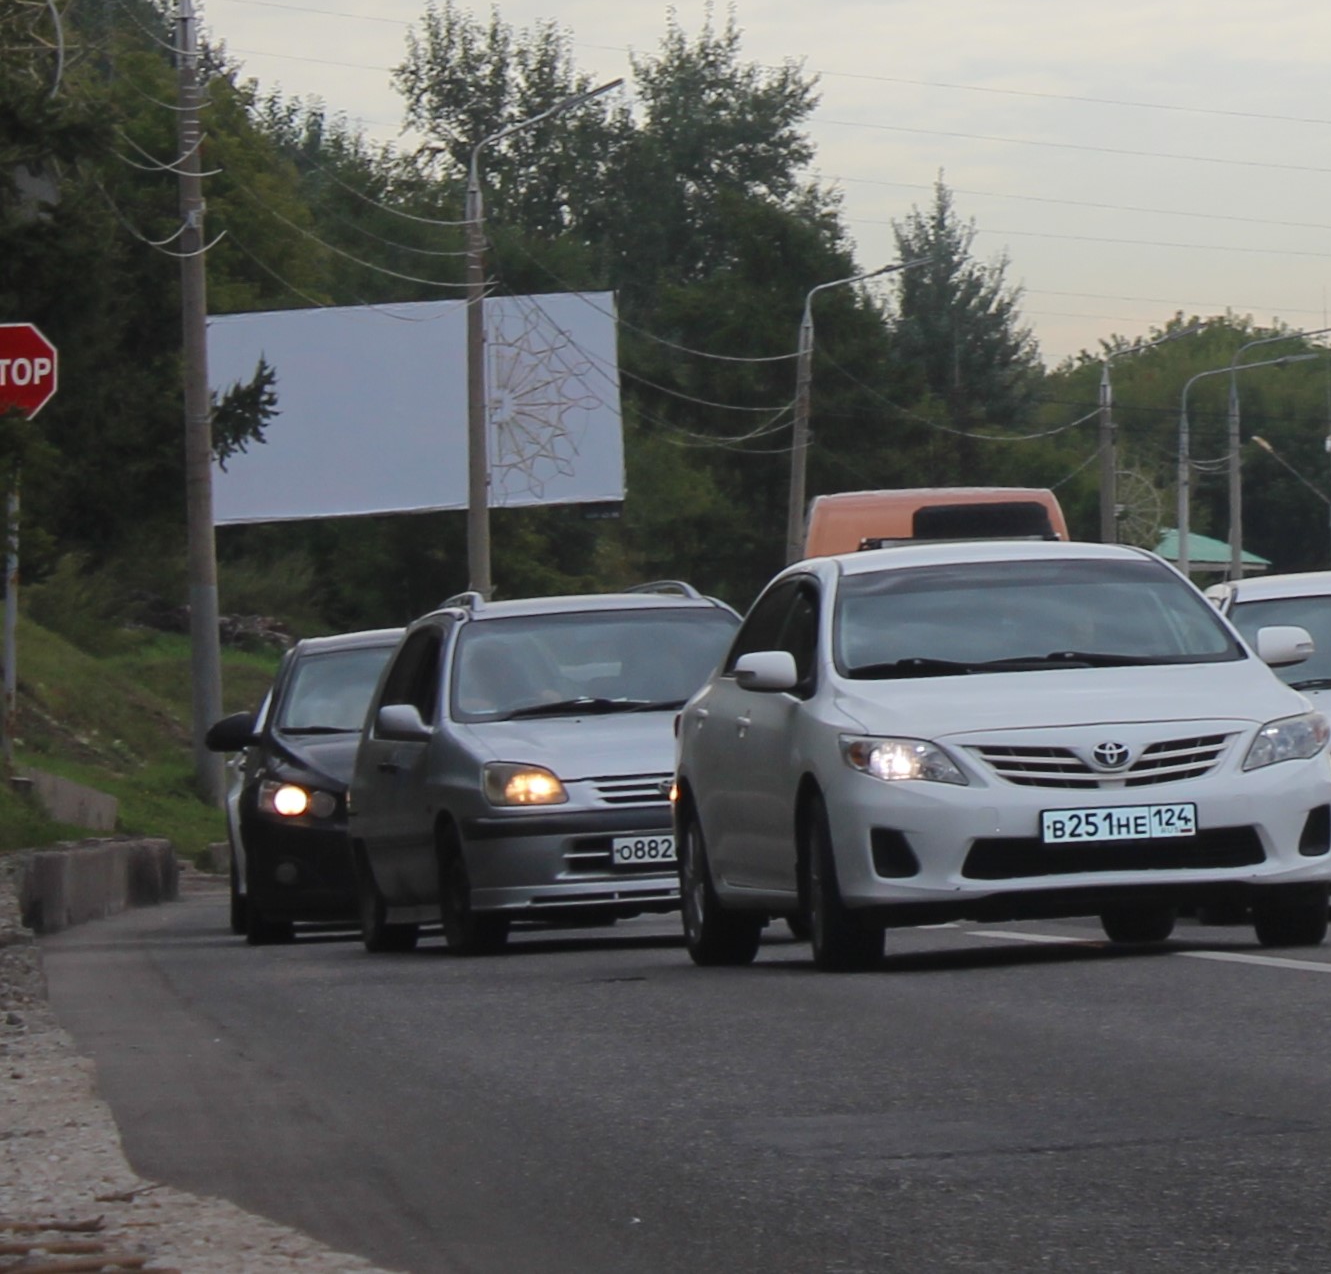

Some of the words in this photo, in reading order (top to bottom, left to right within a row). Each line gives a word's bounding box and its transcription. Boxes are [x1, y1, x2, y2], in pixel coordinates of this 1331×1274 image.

[0, 357, 52, 386] TOP
[1052, 812, 1148, 839] В251НЕ
[1153, 807, 1190, 827] 124
[620, 838, 673, 861] О882
